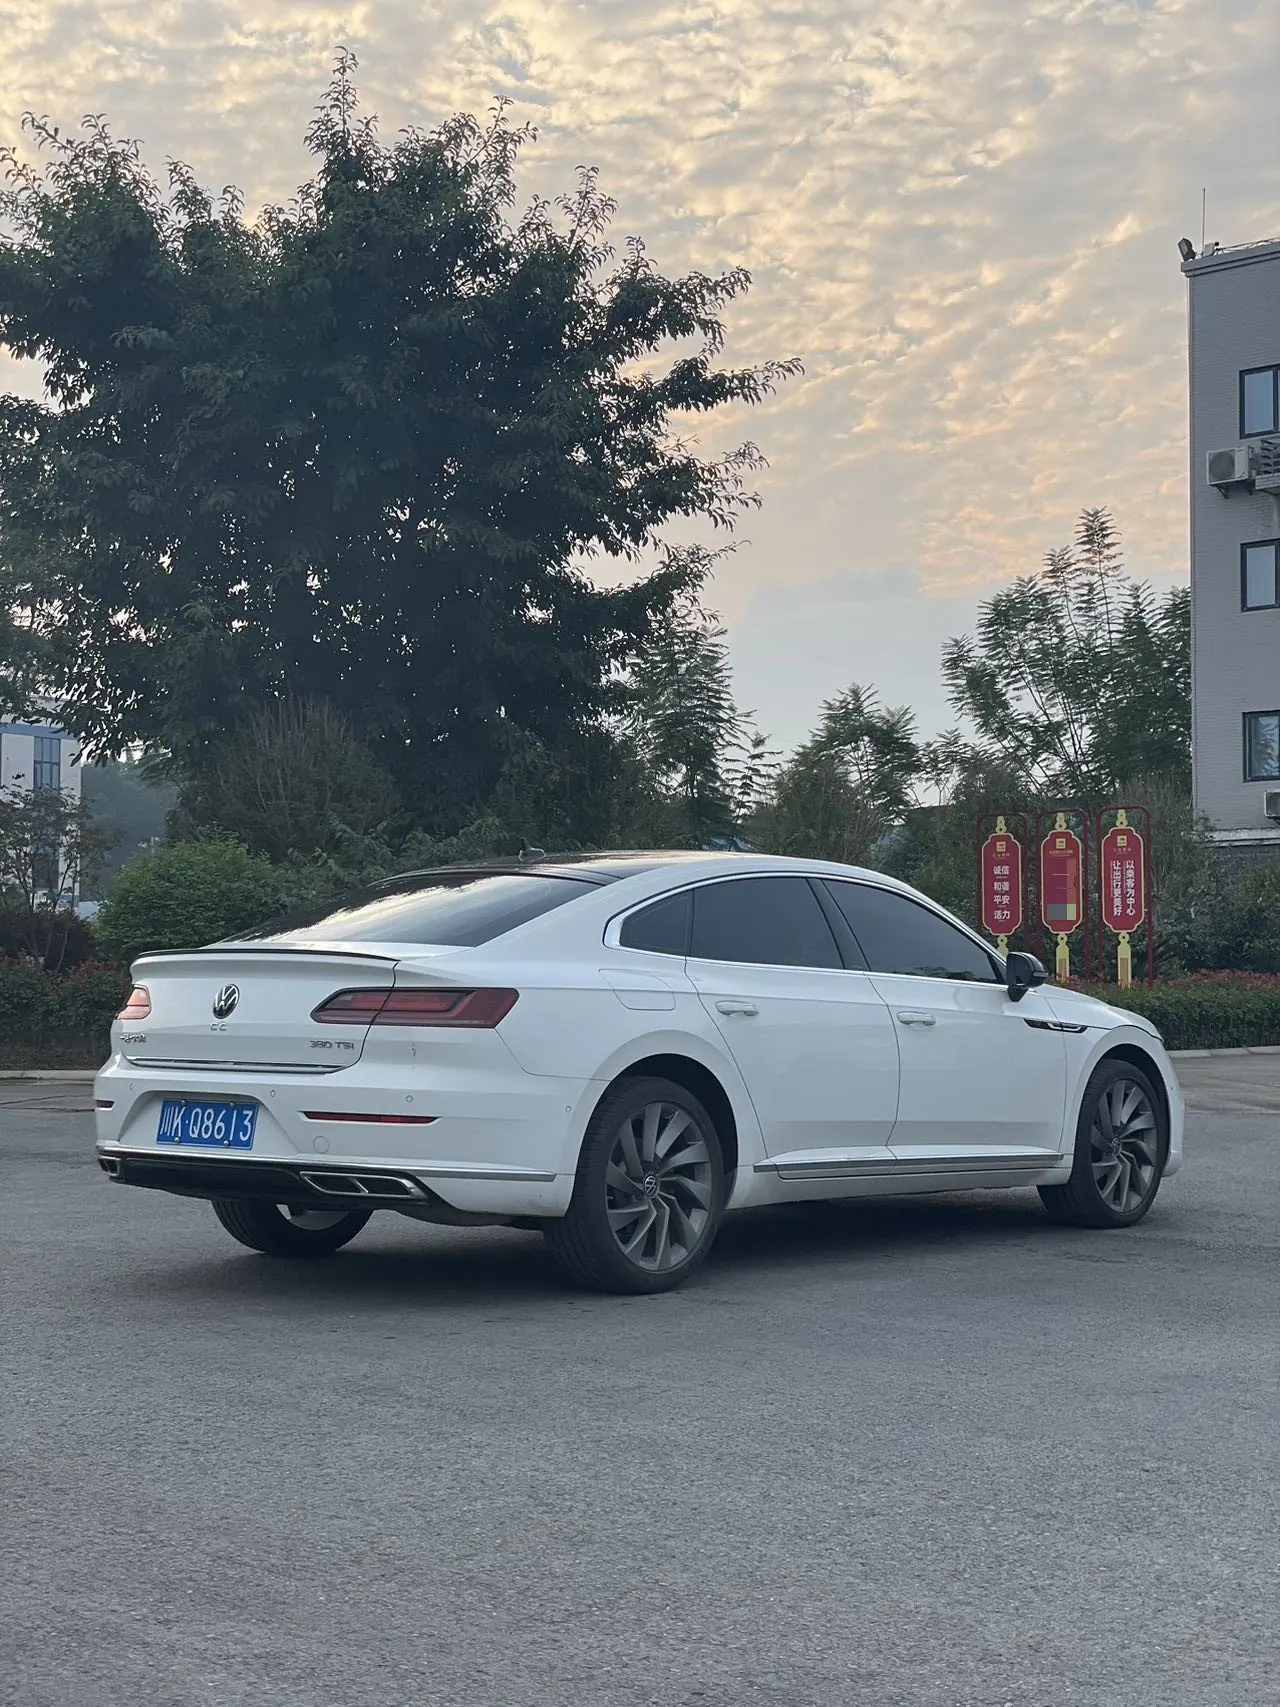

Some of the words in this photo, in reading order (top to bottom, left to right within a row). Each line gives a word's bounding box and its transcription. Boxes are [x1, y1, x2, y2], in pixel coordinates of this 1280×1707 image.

[994, 895, 1010, 905] 平安
[994, 910, 1010, 920] 活力
[210, 1022, 228, 1032] CC
[309, 1040, 333, 1049] 380
[334, 1041, 355, 1050] TSI
